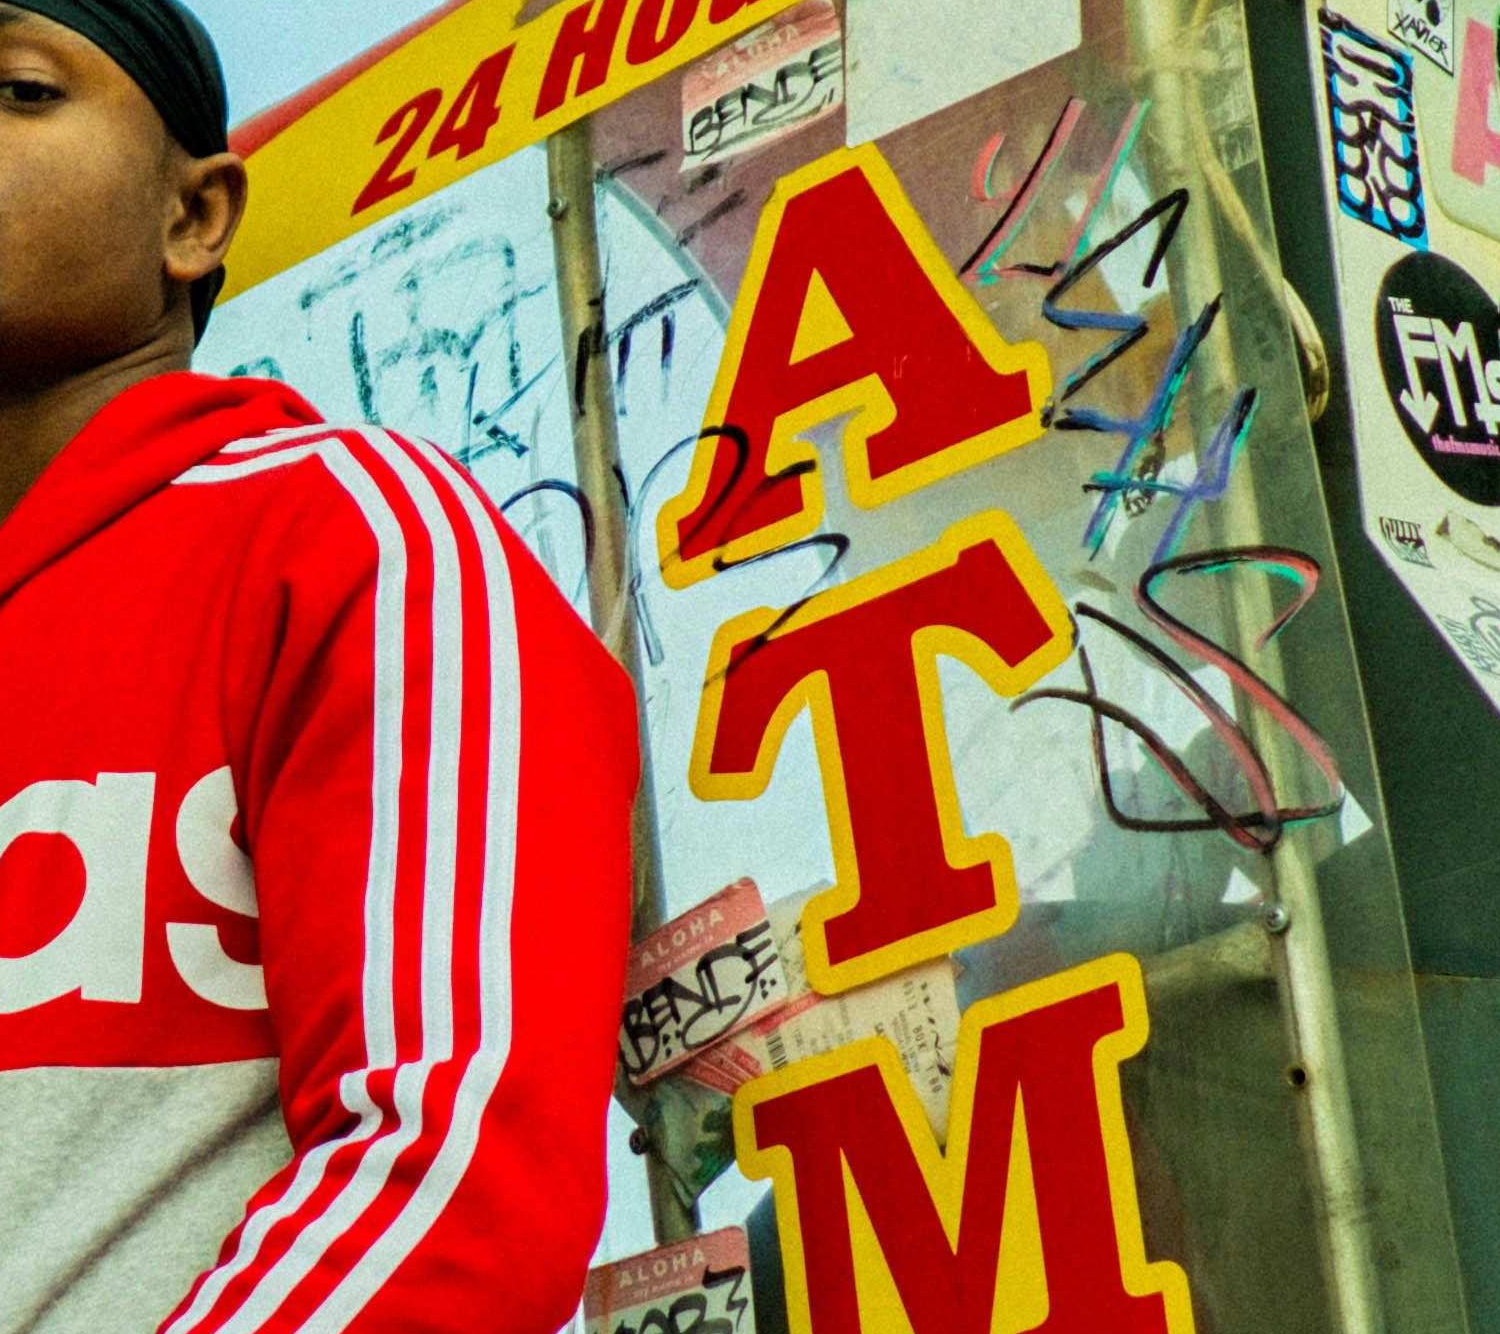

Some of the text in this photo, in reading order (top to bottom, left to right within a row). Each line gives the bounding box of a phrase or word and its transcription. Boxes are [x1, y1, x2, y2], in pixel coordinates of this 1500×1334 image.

[350, 42, 517, 217] 24
[1387, 296, 1414, 315] THE
[641, 908, 725, 969] ALOHA
[618, 1249, 707, 1290] ALOHA
